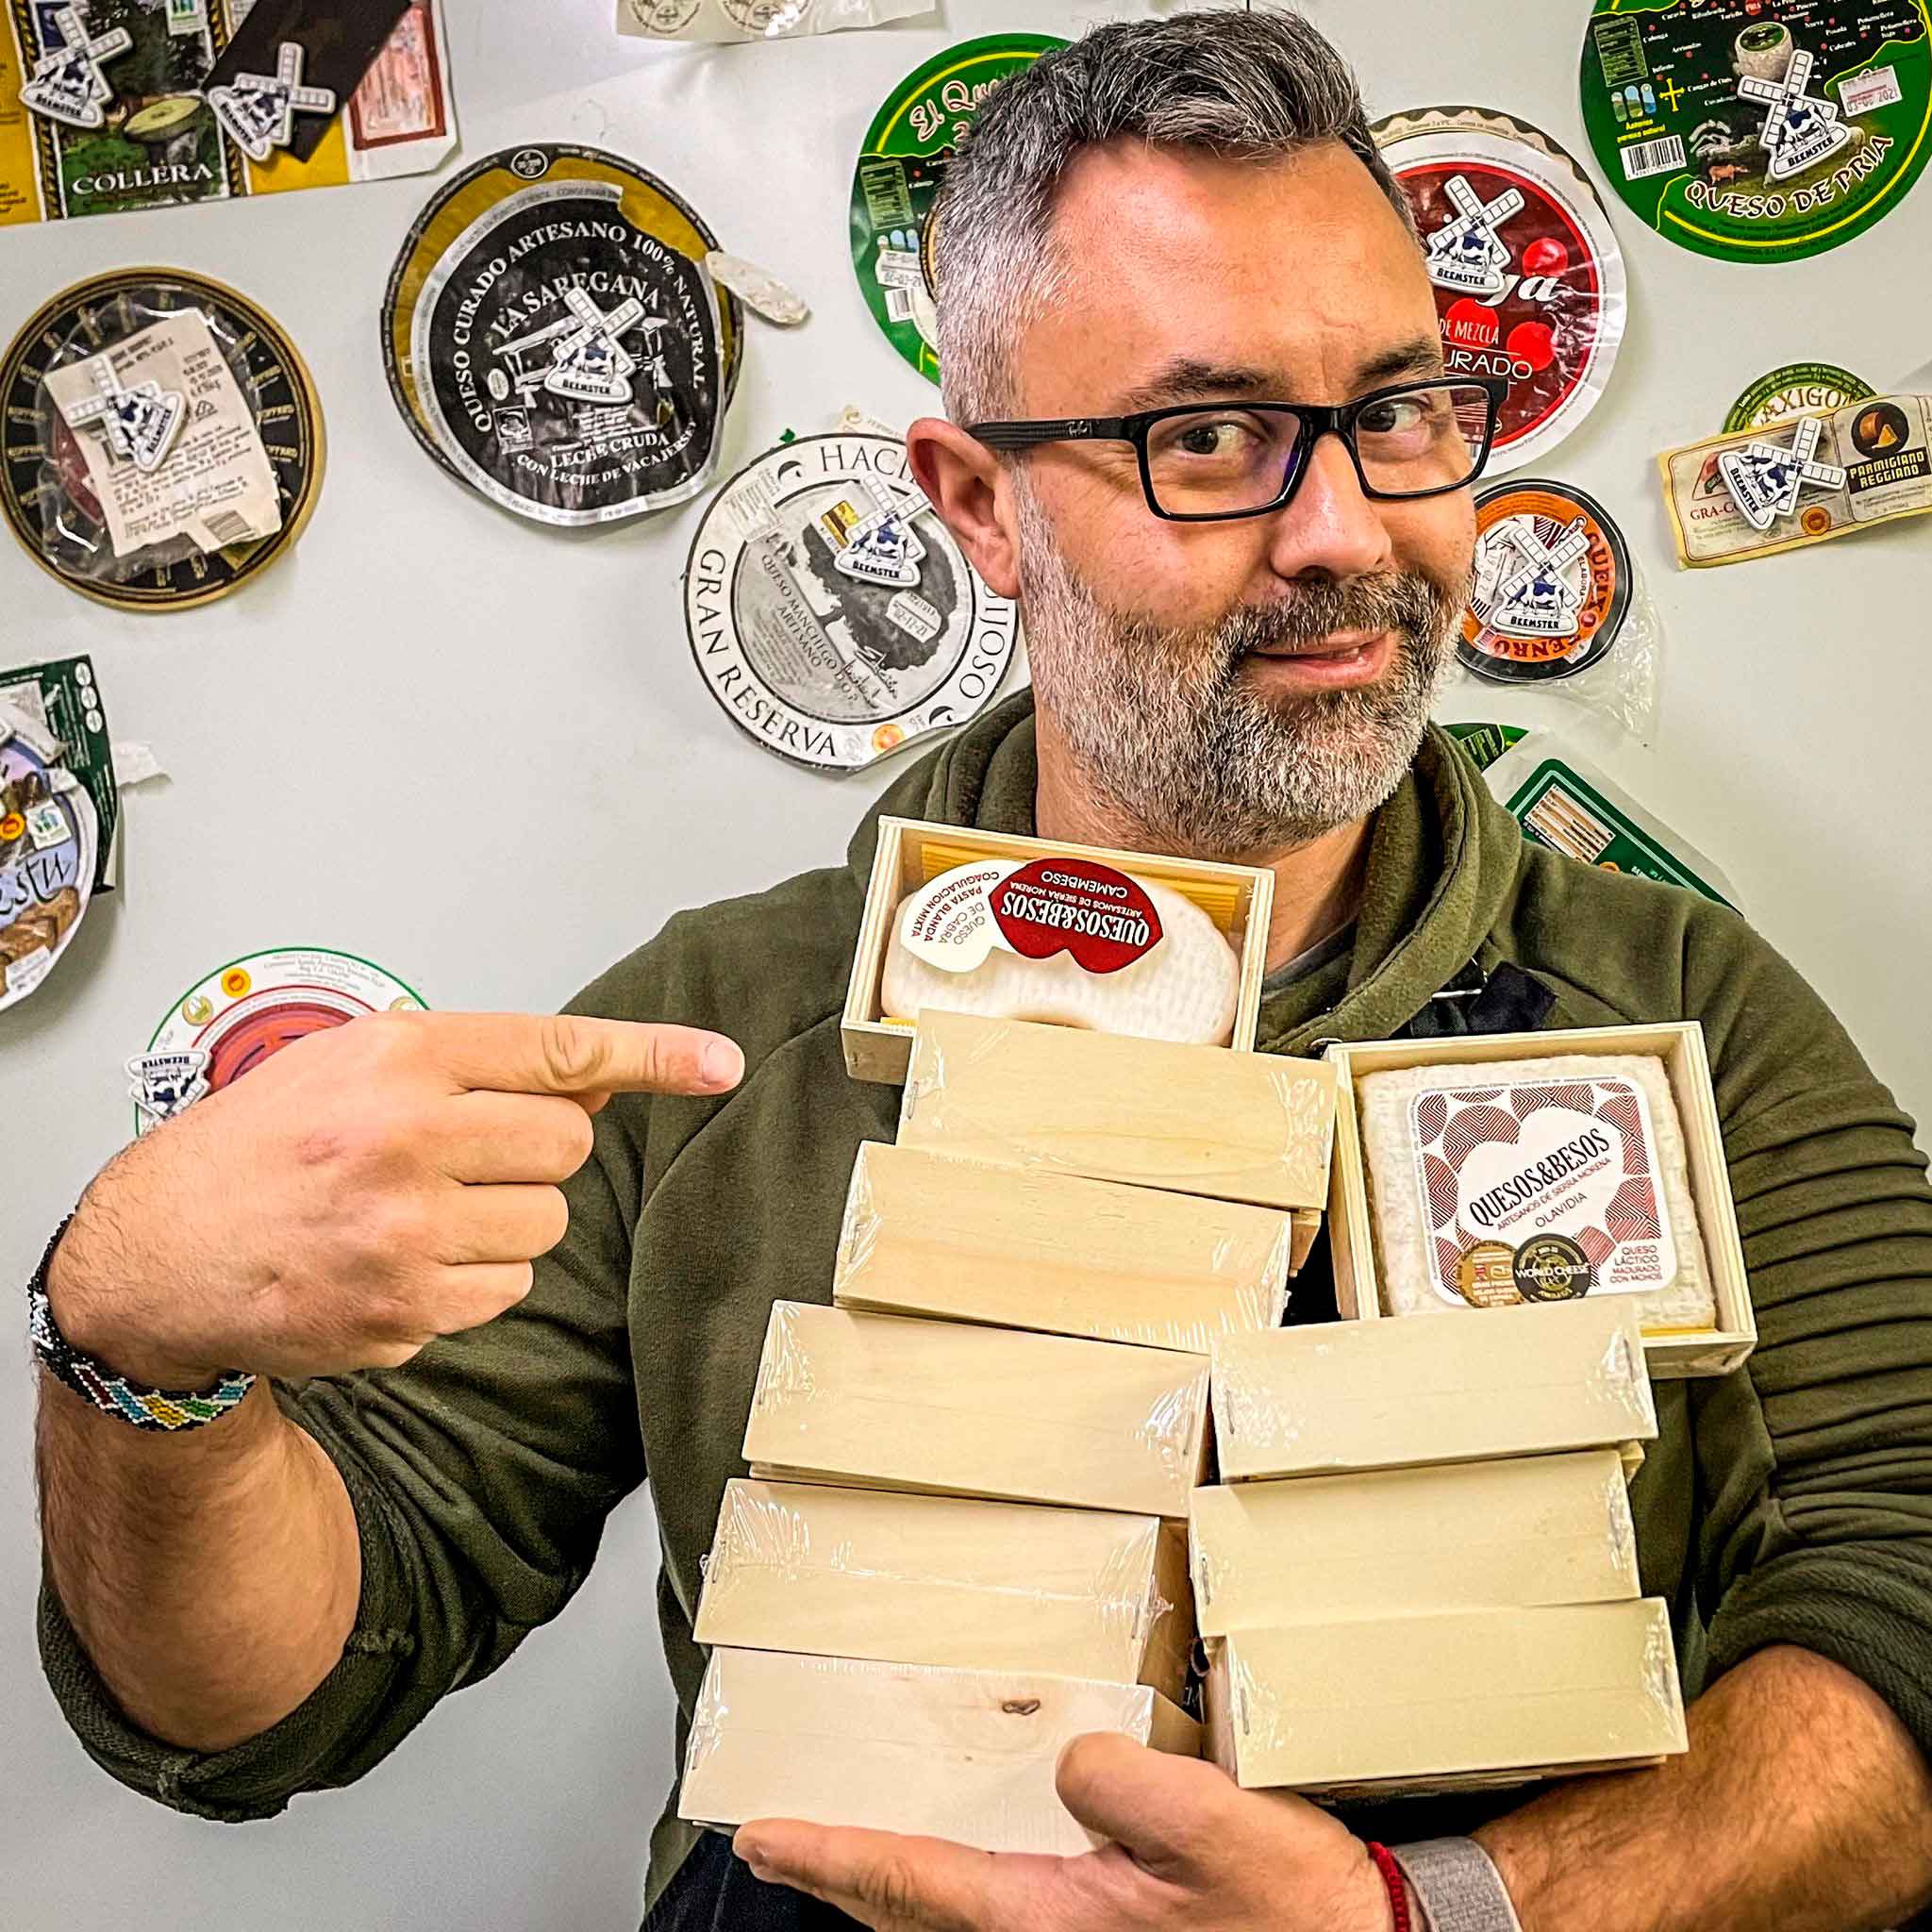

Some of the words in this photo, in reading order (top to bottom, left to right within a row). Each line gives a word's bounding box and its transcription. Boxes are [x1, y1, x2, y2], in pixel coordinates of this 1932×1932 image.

[1788, 138, 1834, 168] BEEMSTER
[72, 162, 214, 195] COLLERA
[1686, 181, 1786, 218] QUESO
[1789, 181, 1835, 212] DE
[1834, 136, 1893, 194] PRIA
[508, 221, 627, 263] ARTESANO
[633, 233, 675, 276] 100%
[1437, 268, 1486, 285] BEEMSTER
[454, 258, 508, 342] CURADO
[491, 307, 528, 339] LA
[674, 274, 706, 389] NATURAL
[1439, 319, 1452, 337] DE
[1454, 320, 1500, 345] MEZCLA
[453, 346, 492, 432] QUESO
[562, 379, 611, 395] BEEMSTER
[551, 443, 608, 469] LECHE
[608, 432, 671, 455] CRUDA
[517, 453, 549, 476] CON
[550, 471, 601, 487] LECHE
[602, 468, 623, 483] DE
[622, 453, 661, 475] VACA
[1849, 451, 1924, 480] PARMIGIANO
[1859, 464, 1920, 489] REGGIANO
[1730, 467, 1760, 514] BEEMSTER
[852, 560, 900, 578] BEEMSTER
[761, 555, 792, 597] QUESO
[790, 598, 838, 670] MANCHEGO
[1510, 616, 1559, 629] BEEMSTER
[696, 549, 729, 655] GRAN
[716, 664, 837, 758] RESERVA
[925, 872, 1000, 909] COAGULACION
[950, 887, 983, 905] PASTA
[1009, 881, 1047, 896] MORENA
[1041, 871, 1128, 899] CAMEMBESO
[1048, 891, 1077, 904] SIERRA
[968, 902, 985, 916] DE
[1078, 897, 1091, 908] DE
[1092, 901, 1142, 918] ARTESANOS
[911, 908, 930, 937] MIXTA
[924, 903, 952, 941] BLANDA
[939, 911, 968, 944] CABRA
[954, 916, 985, 944] QUESO
[1001, 891, 1150, 947] QUESOS&BESOS
[1470, 1128, 1609, 1226] QUESOS&BESOS
[1497, 1199, 1541, 1231] ARTESANOS
[1540, 1191, 1553, 1205] DE
[1552, 1177, 1578, 1197] SIERRA
[1577, 1158, 1611, 1180] MORENA
[1535, 1191, 1588, 1227] OLAVIDIA
[1614, 1255, 1659, 1266] LÁCTICO
[1622, 1244, 1657, 1255] QUESO
[1514, 1268, 1554, 1279] WORLD
[1609, 1274, 1629, 1284] CON
[1632, 1274, 1662, 1282] MOHOS
[1612, 1265, 1661, 1274] MADURADO
